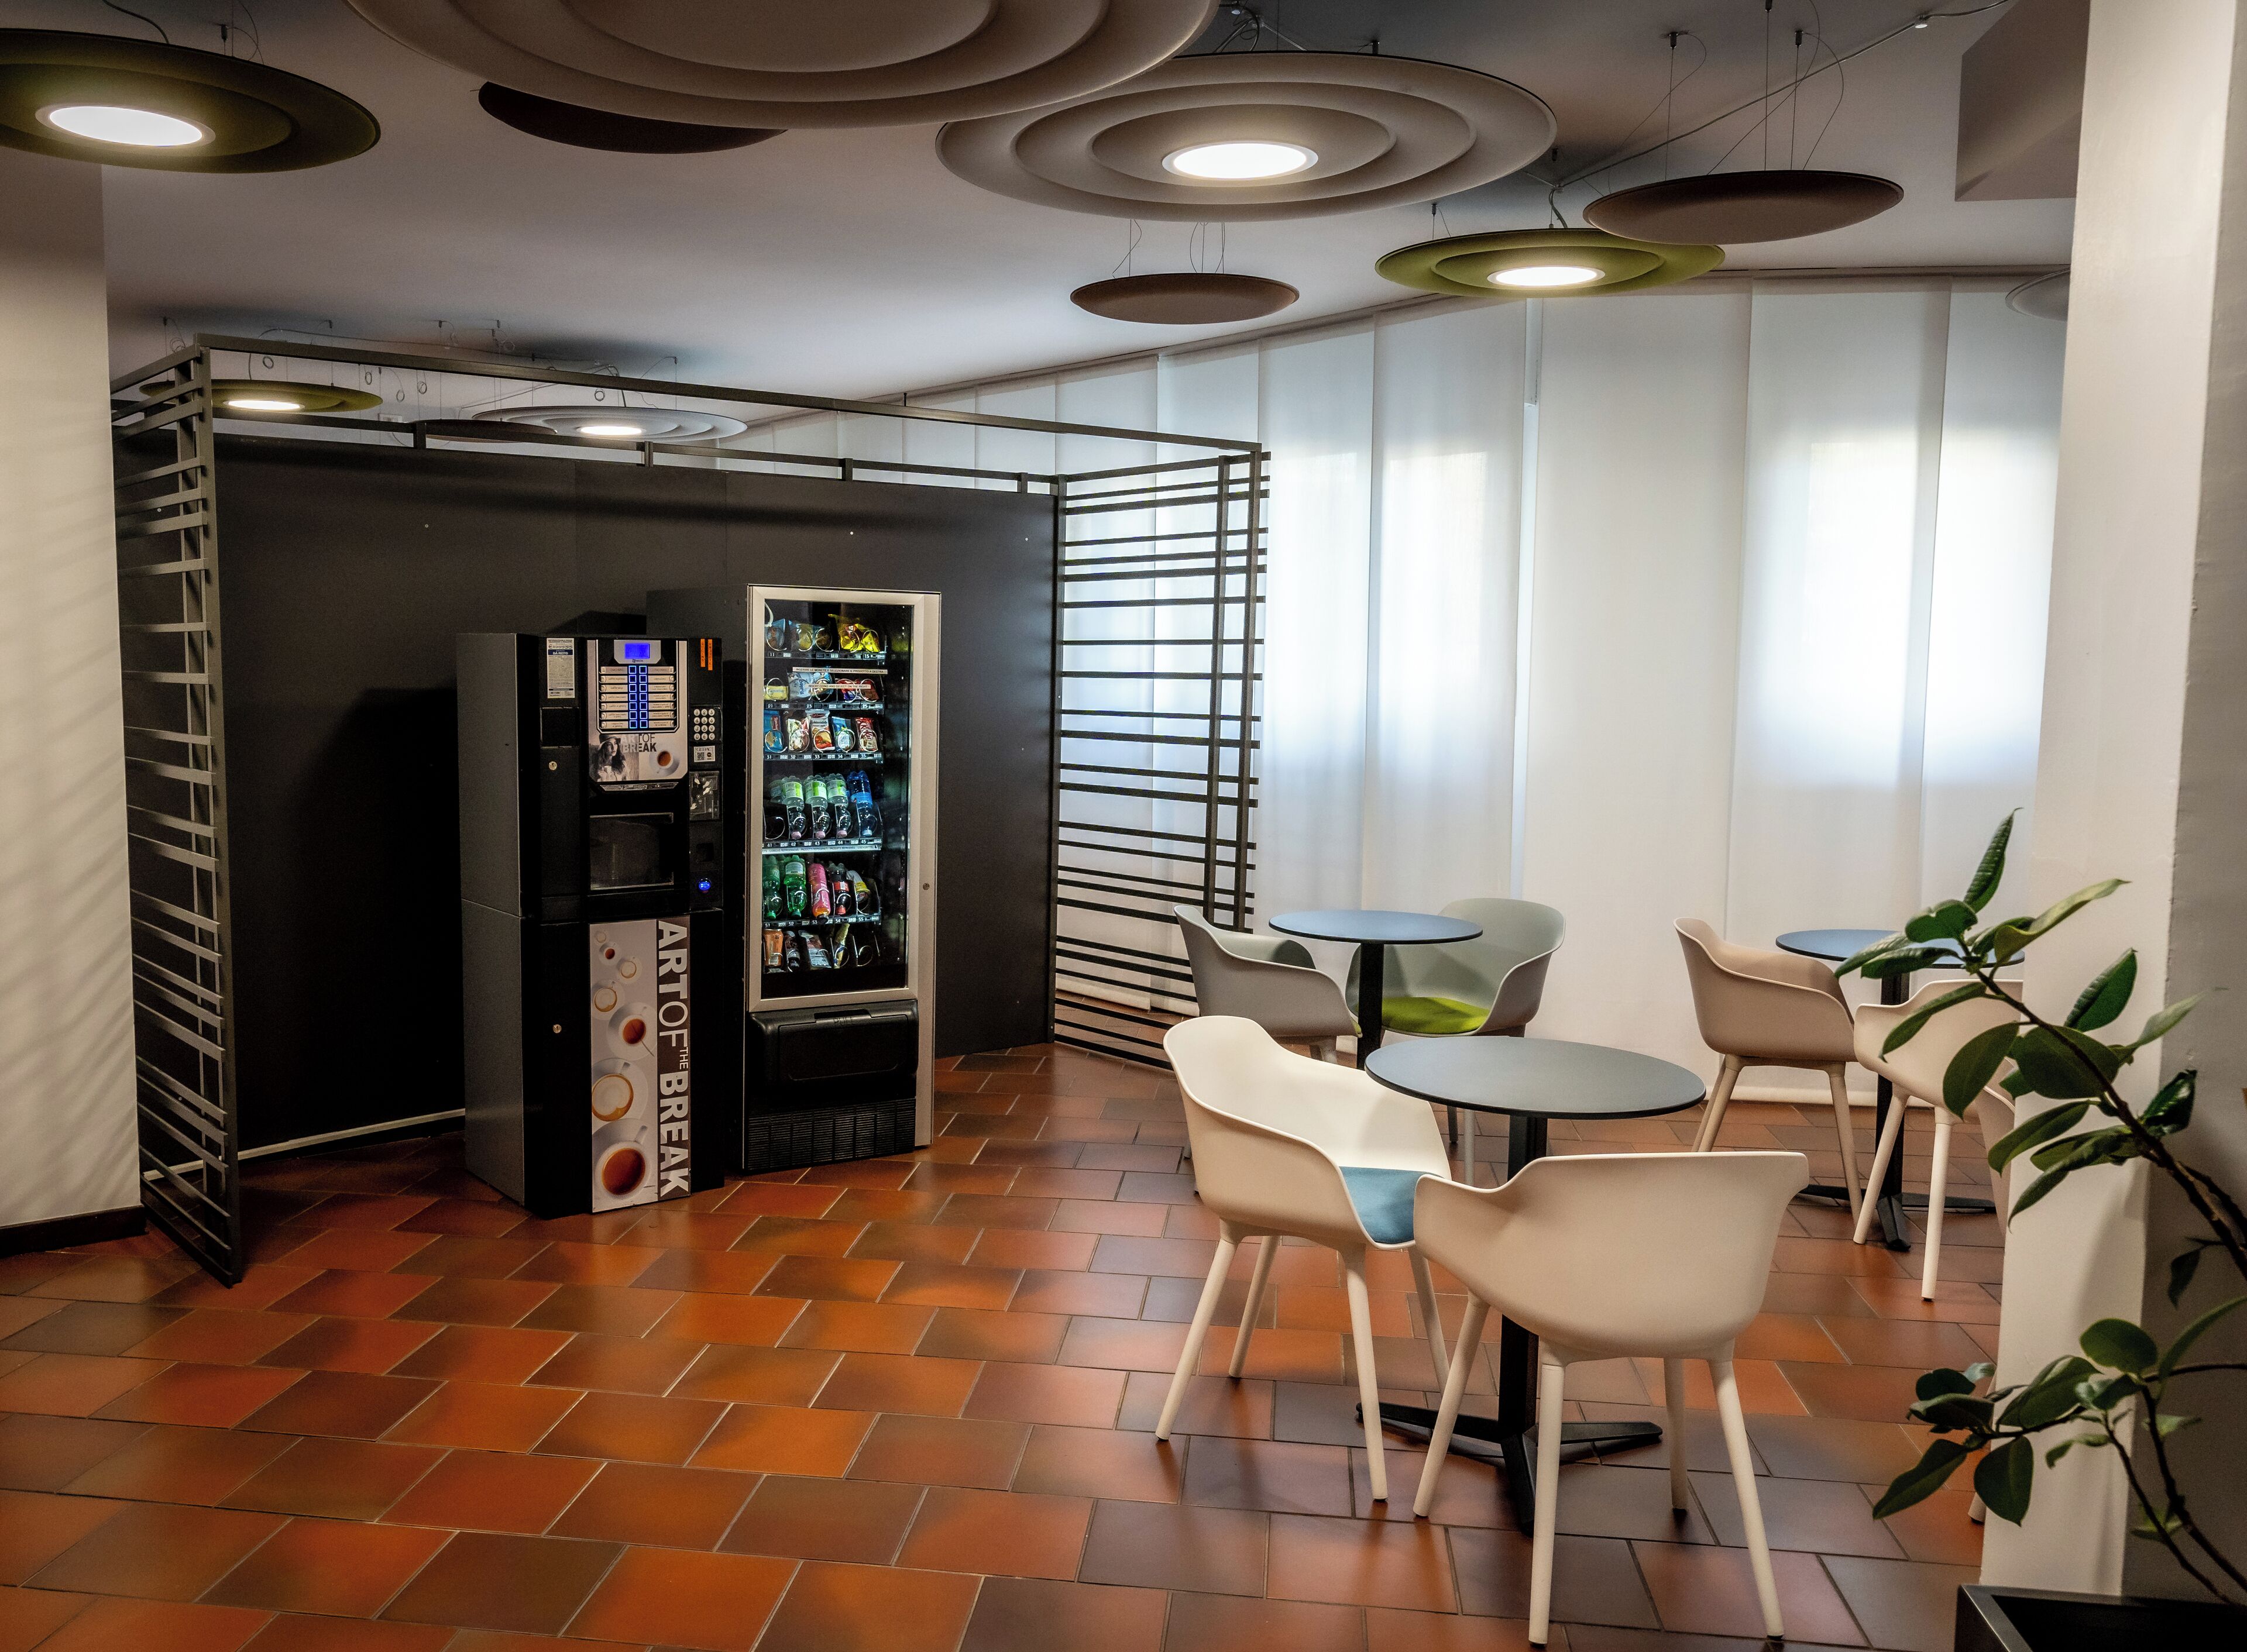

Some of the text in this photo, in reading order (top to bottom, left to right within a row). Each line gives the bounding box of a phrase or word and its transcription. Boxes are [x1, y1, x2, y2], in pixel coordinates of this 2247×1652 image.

[623, 742, 657, 753] BREAK
[679, 1047, 688, 1070] THE
[659, 1071, 689, 1197] BREAK
